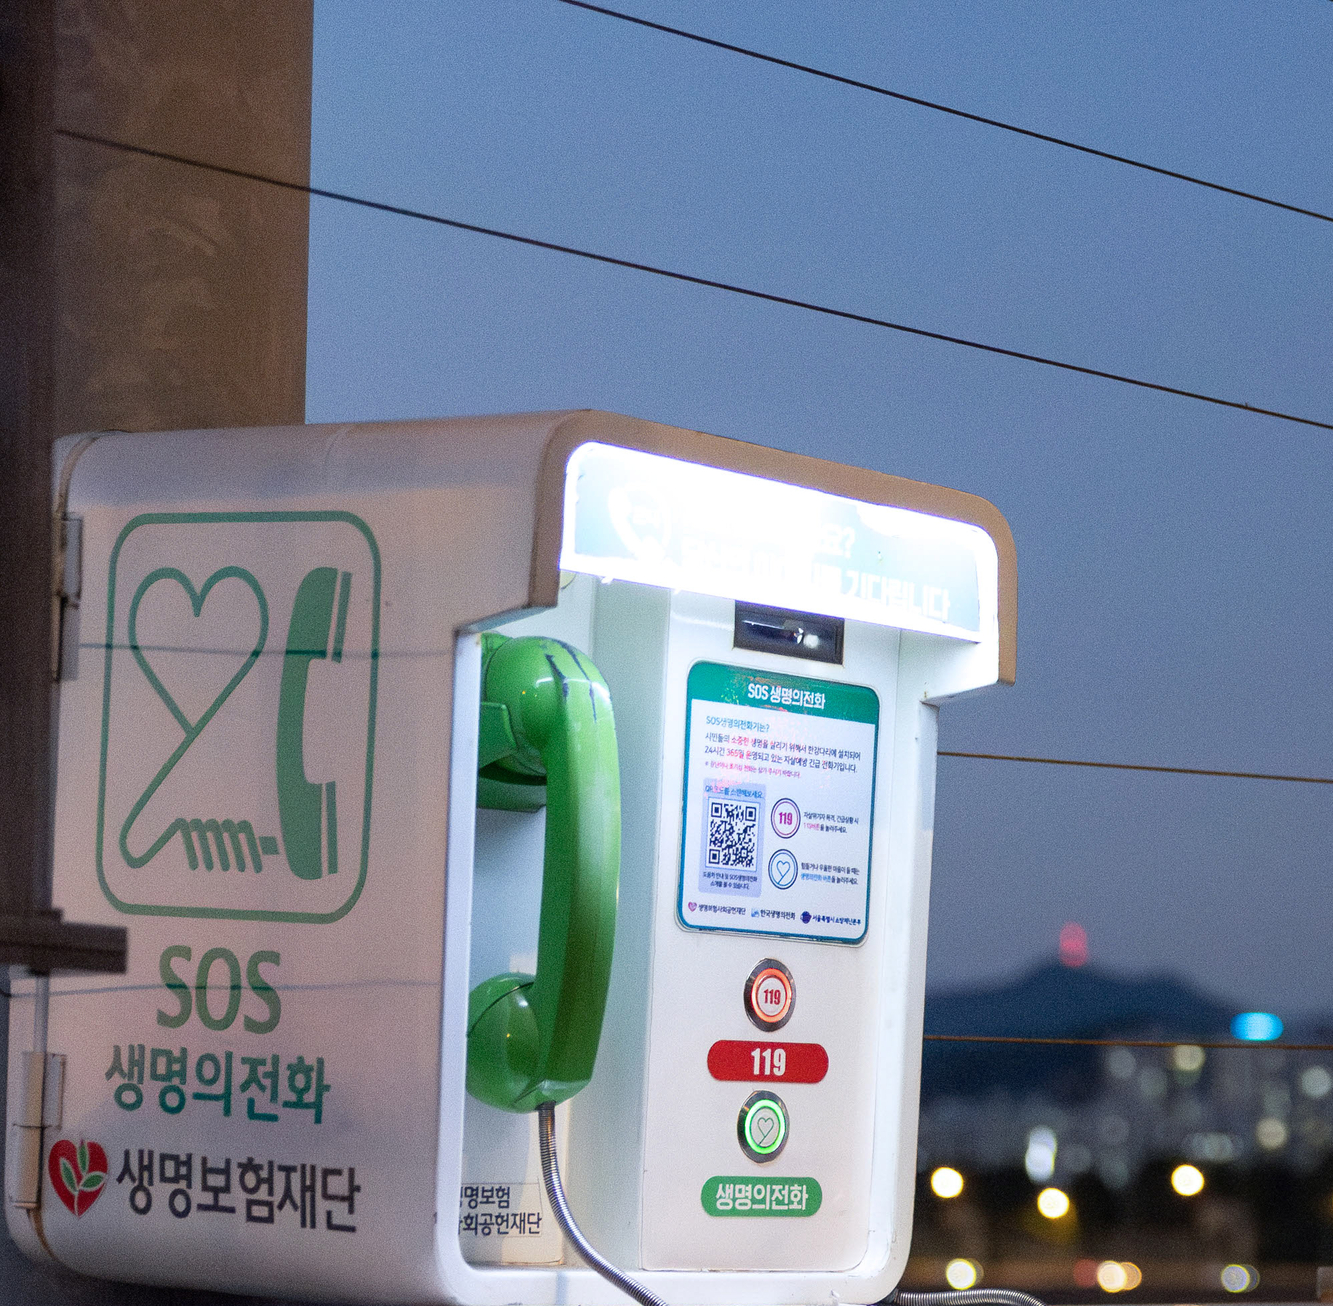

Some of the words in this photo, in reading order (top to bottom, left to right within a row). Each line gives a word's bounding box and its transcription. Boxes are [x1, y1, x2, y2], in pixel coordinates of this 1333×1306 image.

[748, 683, 769, 700] SOS
[770, 686, 826, 709] 생명의전화
[706, 716, 769, 732] SOS생명의전화기는?
[705, 732, 730, 743] 시민들의
[731, 735, 749, 746] 소중한
[751, 738, 768, 749] 생명을
[770, 740, 787, 751] 살리기
[789, 743, 806, 754] 위해서
[808, 745, 837, 757] 한강다리에
[838, 749, 861, 761] 설치되어
[705, 745, 725, 757] 24시간
[727, 748, 744, 759] 365일
[746, 750, 769, 761] 운영되고
[771, 753, 782, 764] 있는
[784, 755, 807, 767] 자살예방
[809, 759, 820, 769] 긴급
[778, 812, 793, 825] 119
[760, 909, 796, 920] 한국생명의전화
[156, 945, 282, 1034] SOS
[763, 989, 781, 1005] 119
[751, 1048, 786, 1076] 119
[105, 1043, 331, 1124] 생명의전화
[116, 1149, 361, 1243] 생명보험재단
[460, 1186, 510, 1209] 명보험
[716, 1183, 808, 1211] 생명의전화
